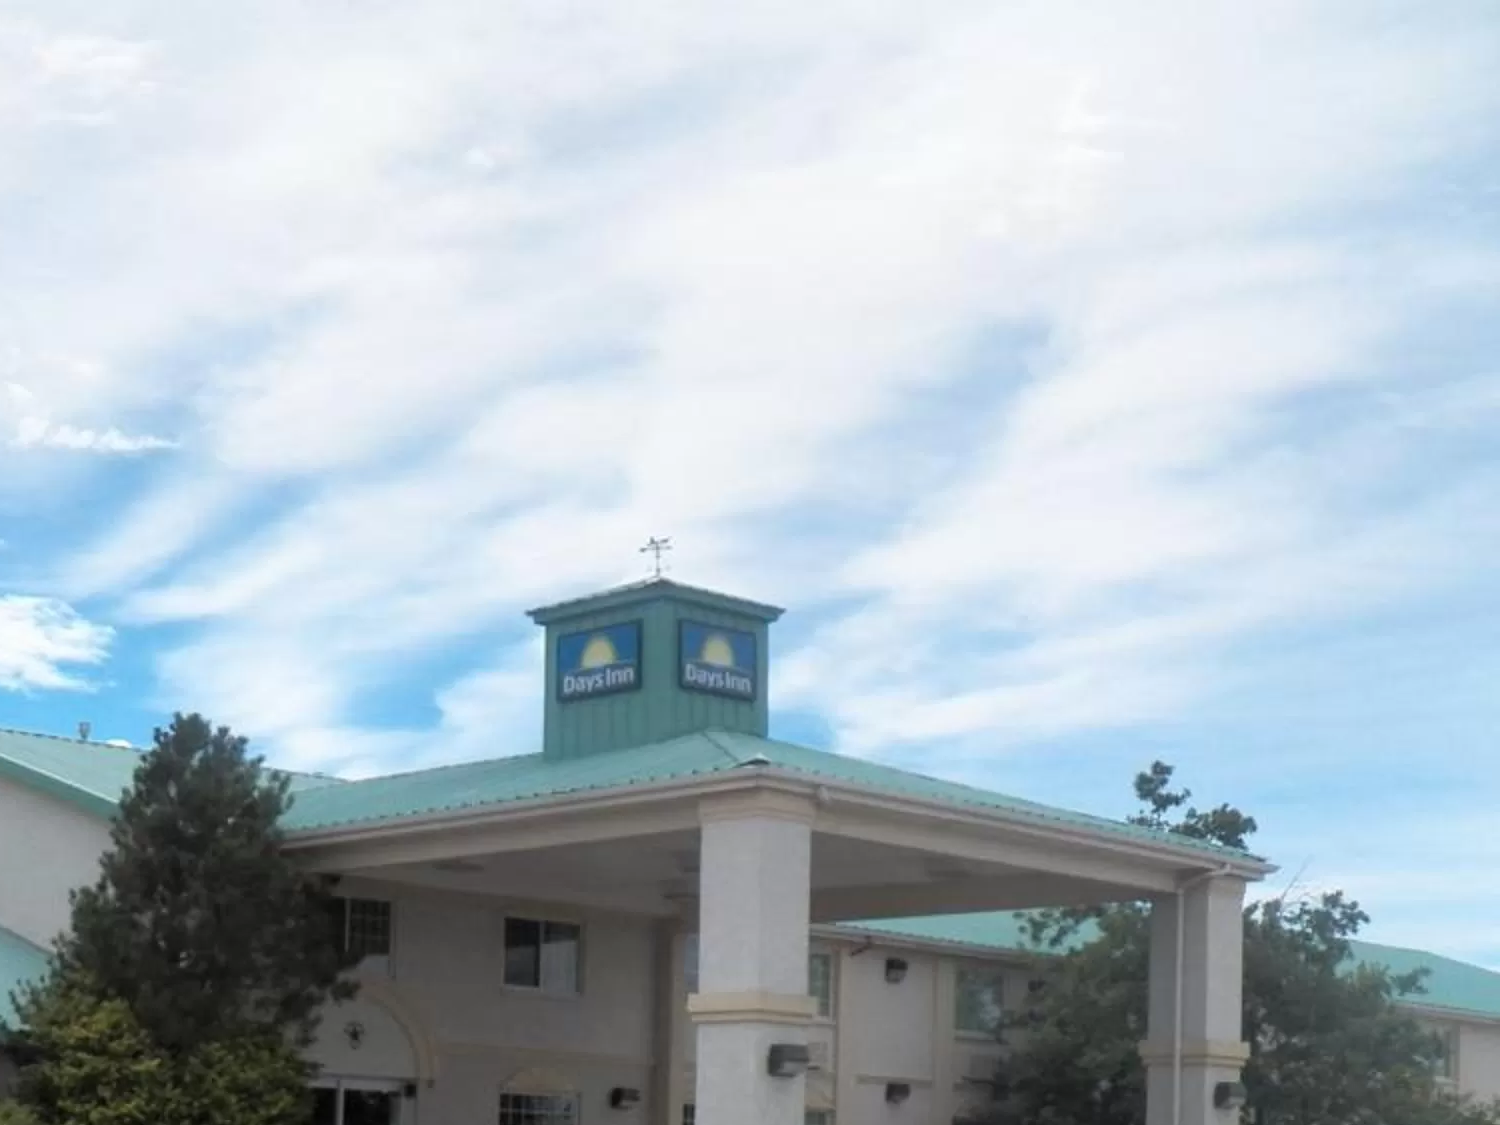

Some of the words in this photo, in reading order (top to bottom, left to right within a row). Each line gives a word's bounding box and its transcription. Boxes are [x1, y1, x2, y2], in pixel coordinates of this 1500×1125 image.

[563, 671, 604, 695] Days
[605, 666, 634, 687] Inn
[684, 663, 724, 690] Days
[725, 671, 752, 694] Inn
